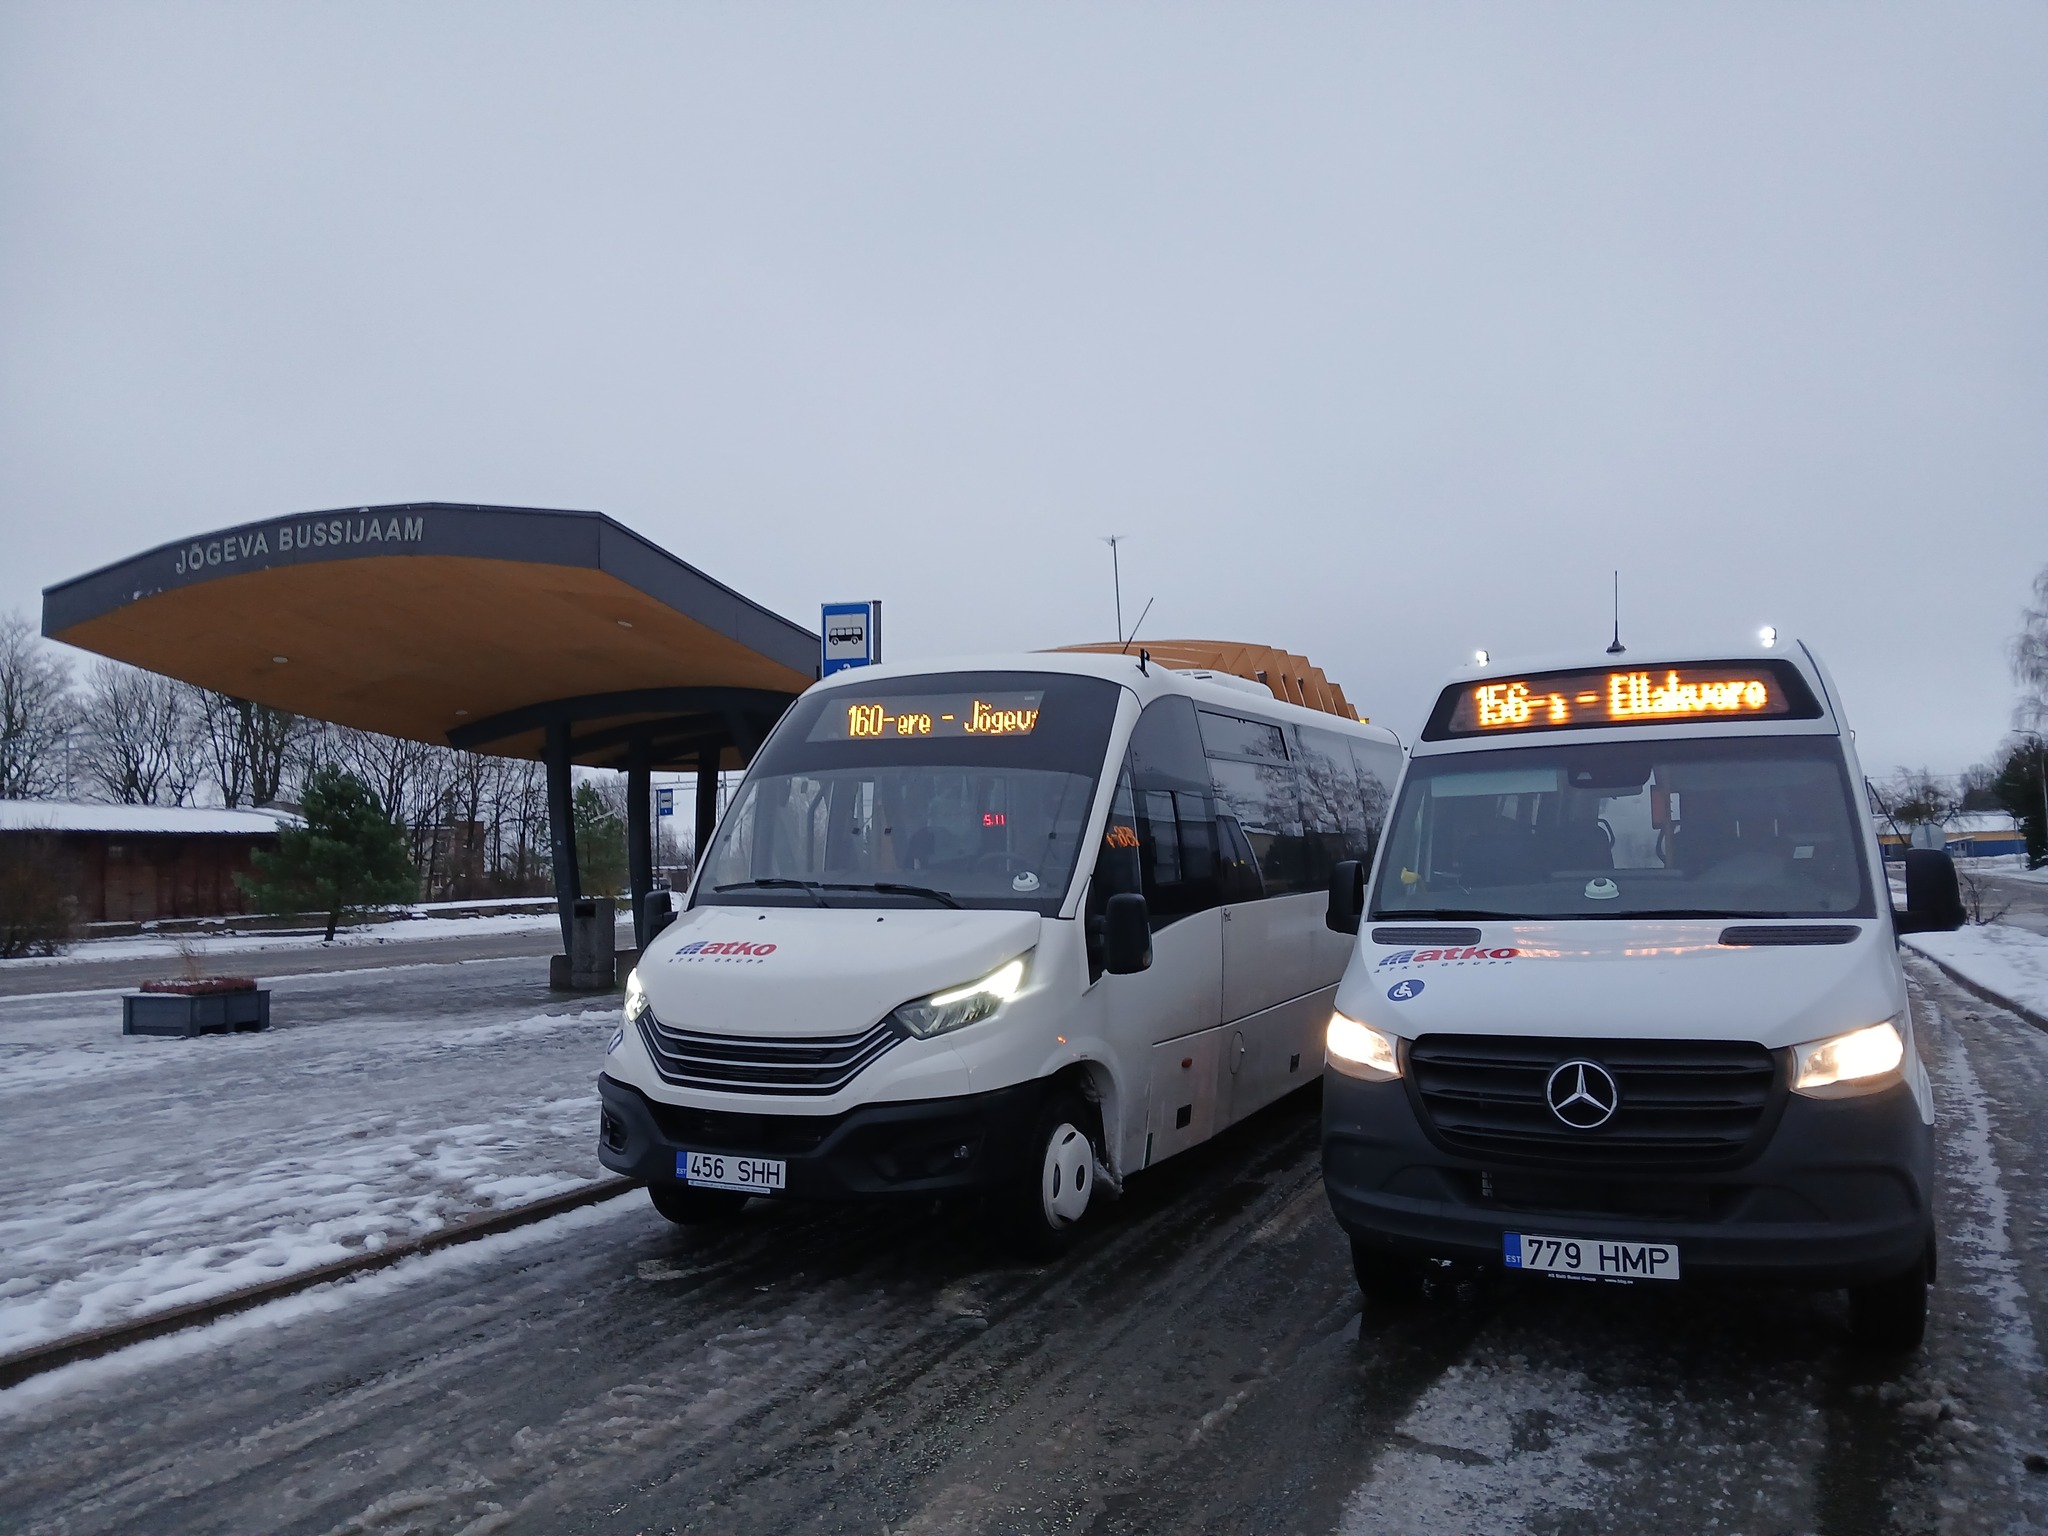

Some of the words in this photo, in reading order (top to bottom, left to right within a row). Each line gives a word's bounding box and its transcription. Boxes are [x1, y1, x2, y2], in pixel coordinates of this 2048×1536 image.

[175, 532, 269, 575] JÕGEVA
[279, 516, 424, 551] BUSSIJAAM
[848, 704, 932, 737] 160-ere
[699, 941, 777, 956] atko
[1412, 946, 1521, 963] atko
[691, 1155, 725, 1179] 456
[737, 1160, 780, 1185] SHH
[1506, 1254, 1522, 1264] EST
[1528, 1239, 1581, 1269] 779
[1598, 1244, 1670, 1275] HMP
